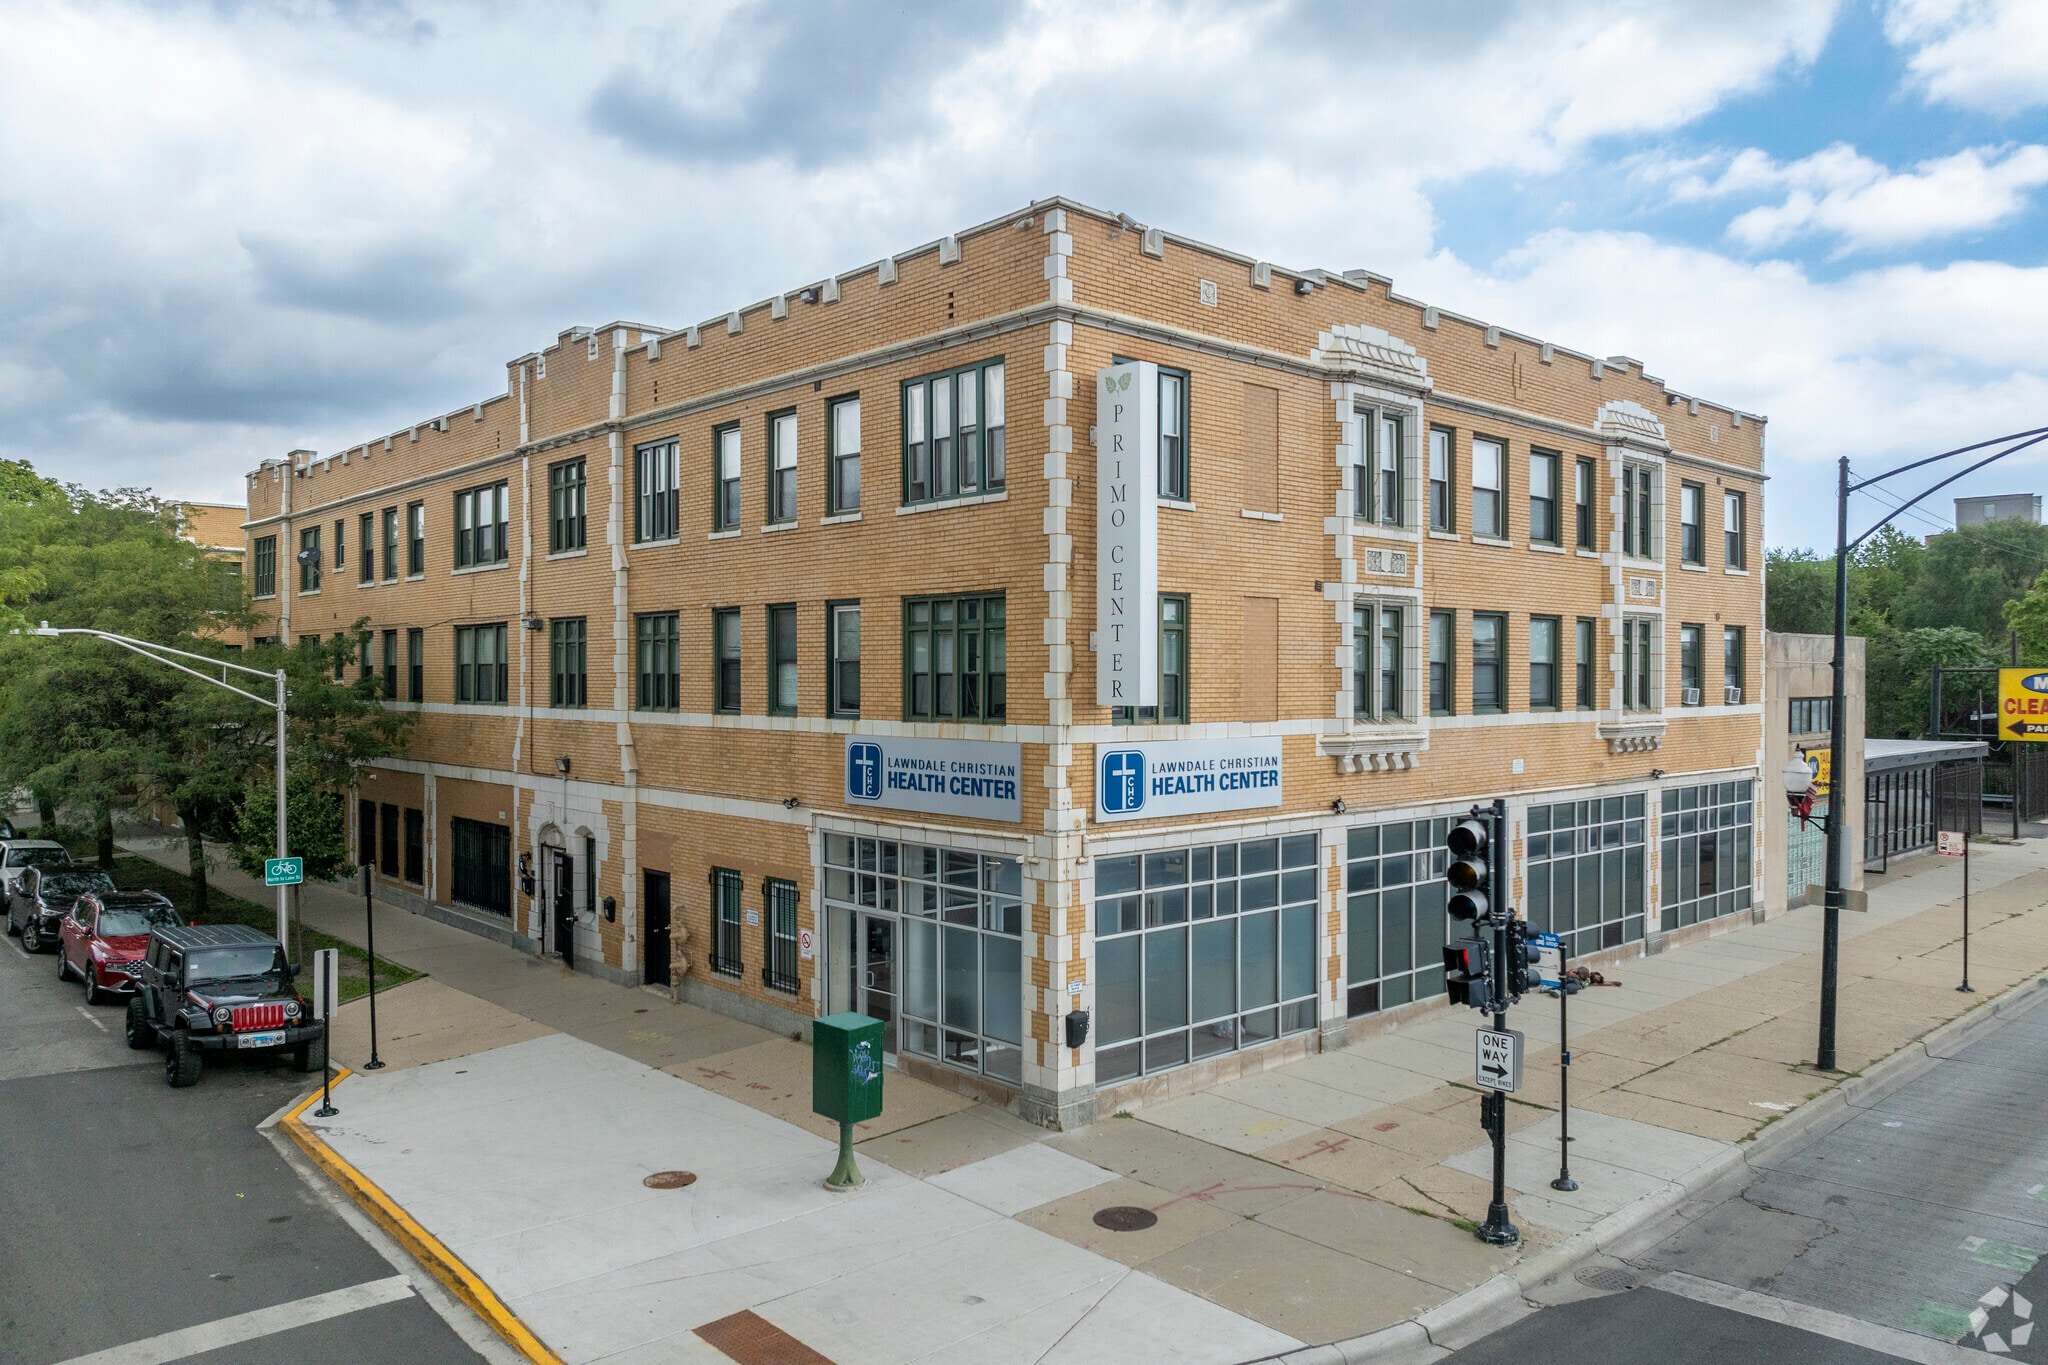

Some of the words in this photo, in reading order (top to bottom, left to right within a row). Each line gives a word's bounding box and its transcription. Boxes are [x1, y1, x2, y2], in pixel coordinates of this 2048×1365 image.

[1110, 404, 1126, 527] PRIMO
[1110, 545, 1124, 698] CENTER
[887, 757, 946, 772] LAWNDALE
[951, 761, 1015, 777] CHRISTIAN
[1152, 759, 1215, 774] LAWNDALE
[1220, 756, 1278, 770] CHRISTIAN
[887, 771, 946, 794] HEALTH
[950, 776, 1016, 800] CENTER
[1152, 774, 1215, 796] HEALTH
[1219, 769, 1278, 791] CENTER
[1483, 1035, 1508, 1050] ONE
[1482, 1048, 1508, 1064] WAY
[1479, 1075, 1496, 1086] EXCEPT
[1498, 1080, 1512, 1088] BIKES
